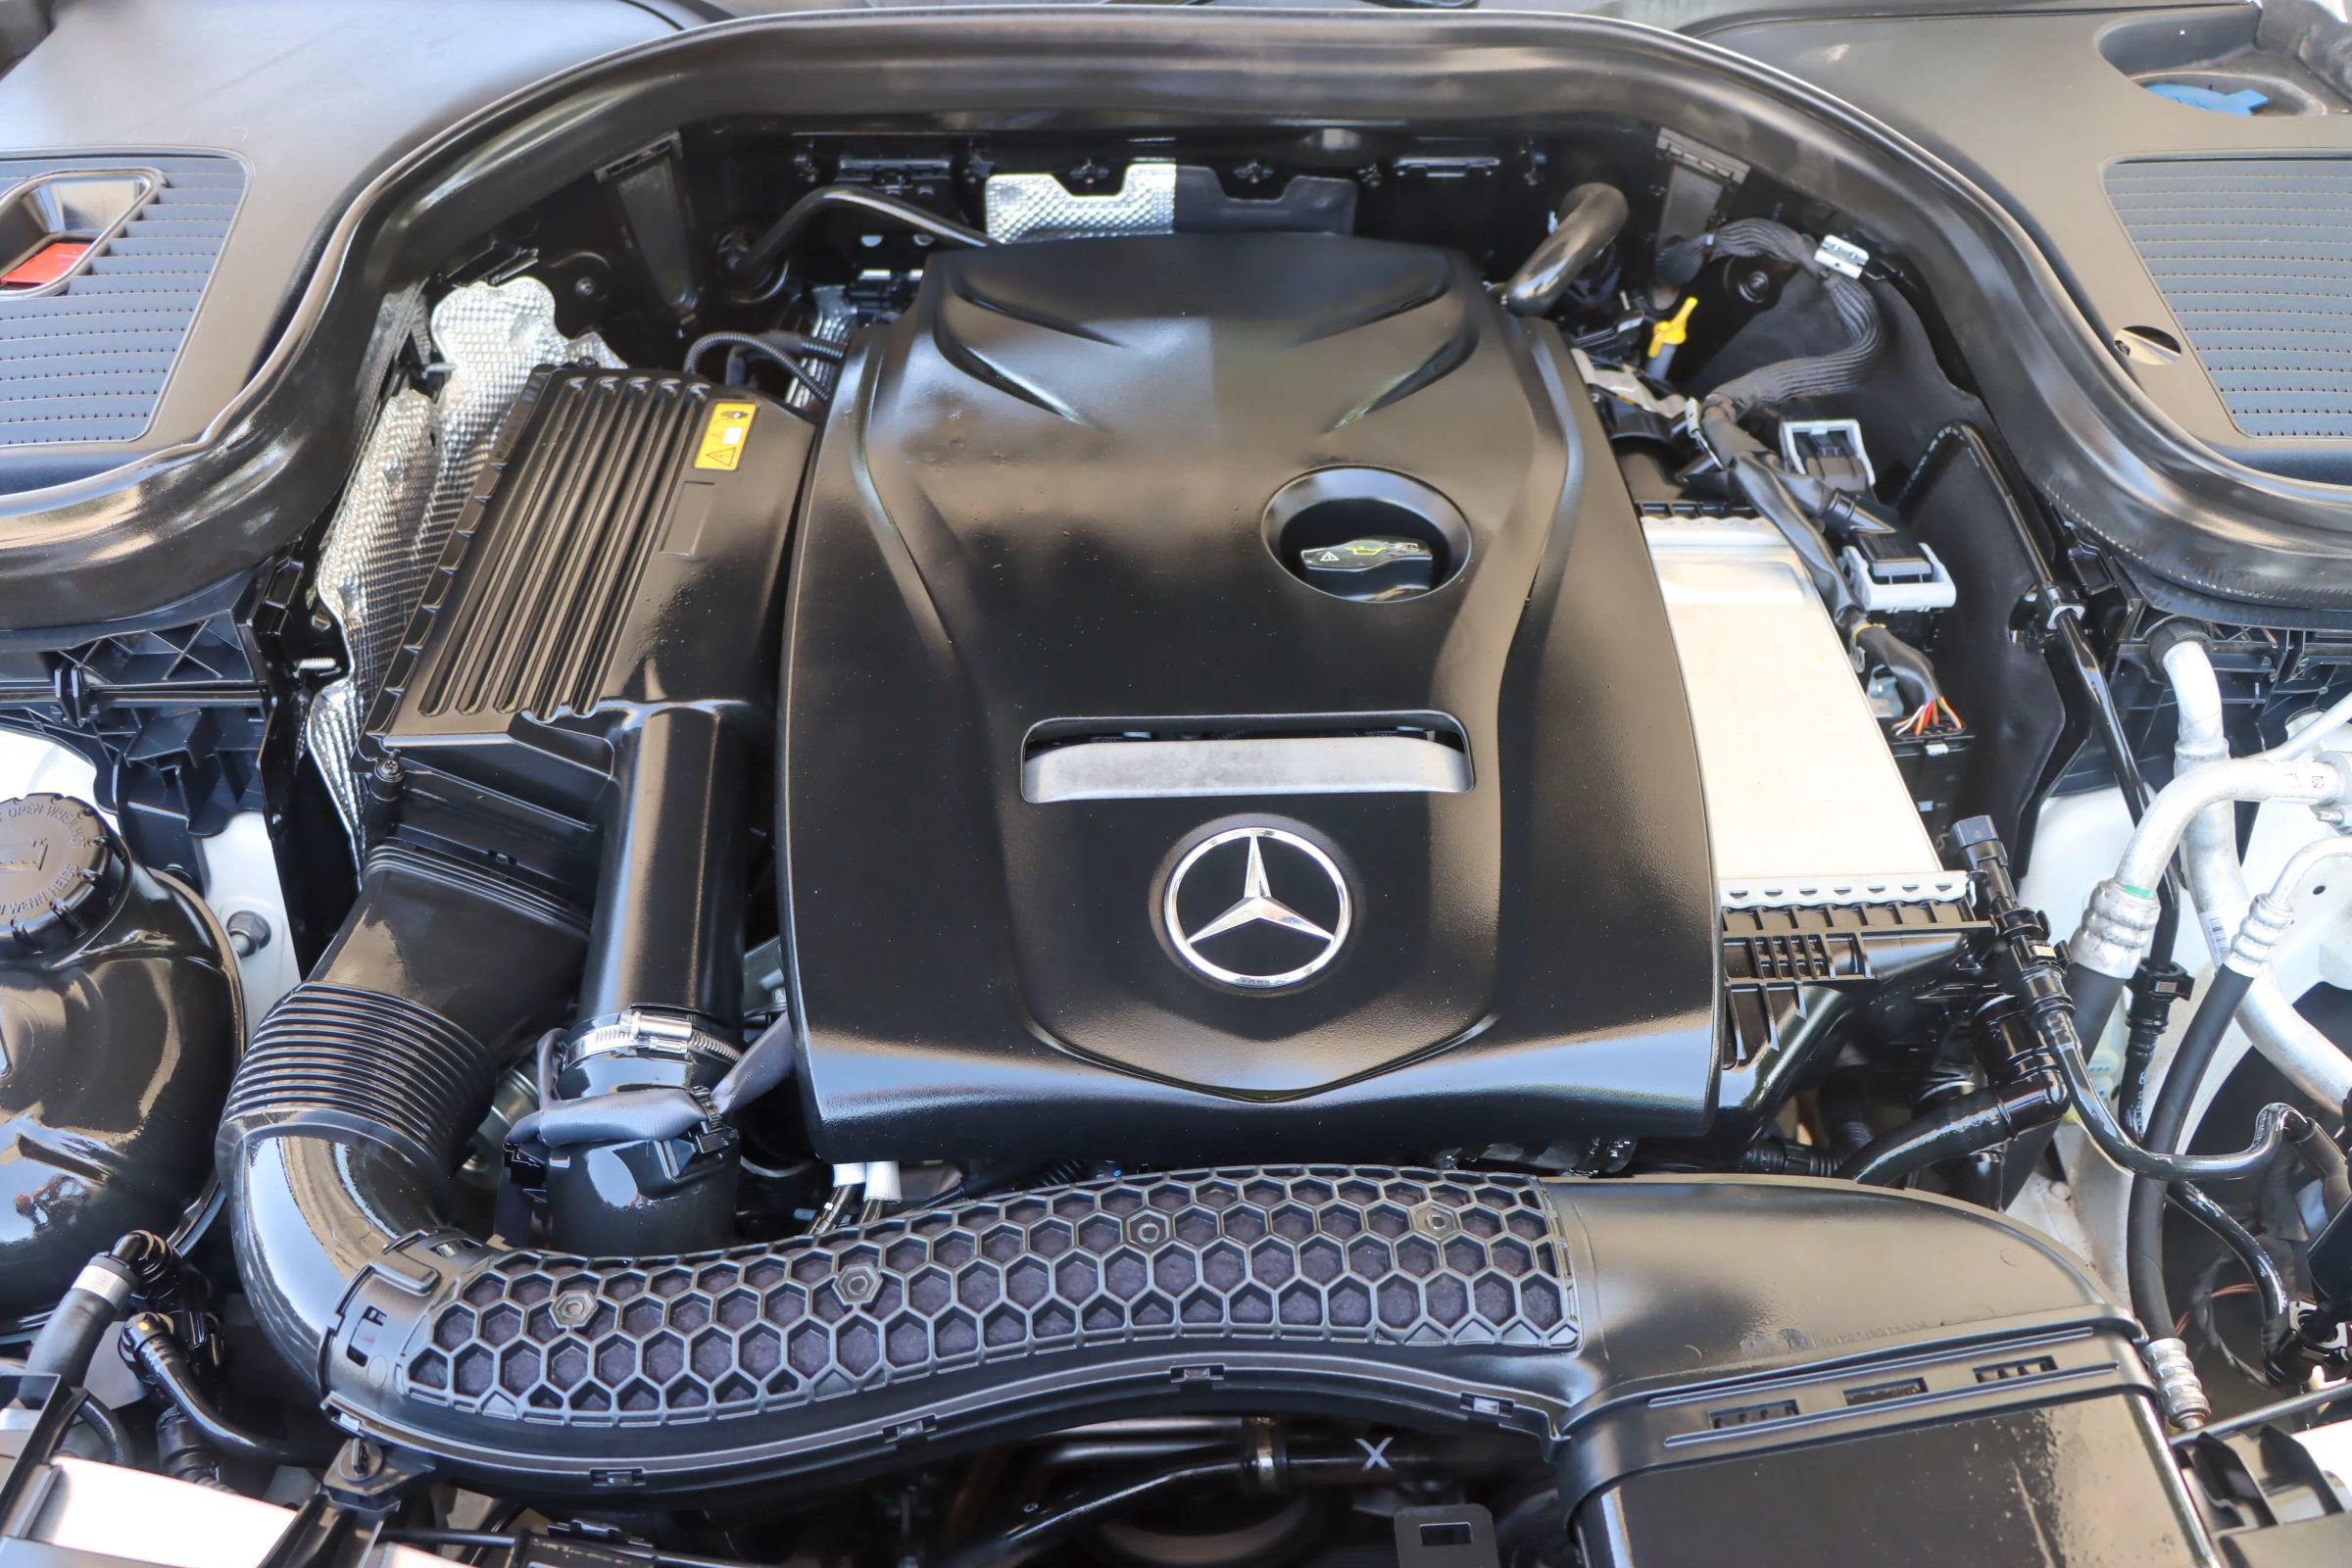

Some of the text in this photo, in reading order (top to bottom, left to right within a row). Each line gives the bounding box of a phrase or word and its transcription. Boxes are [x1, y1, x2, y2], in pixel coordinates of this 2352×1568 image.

[8, 803, 44, 817] OPEN
[46, 805, 79, 828] WHEN
[9, 891, 49, 914] WENN
[47, 861, 79, 897] HEISS
